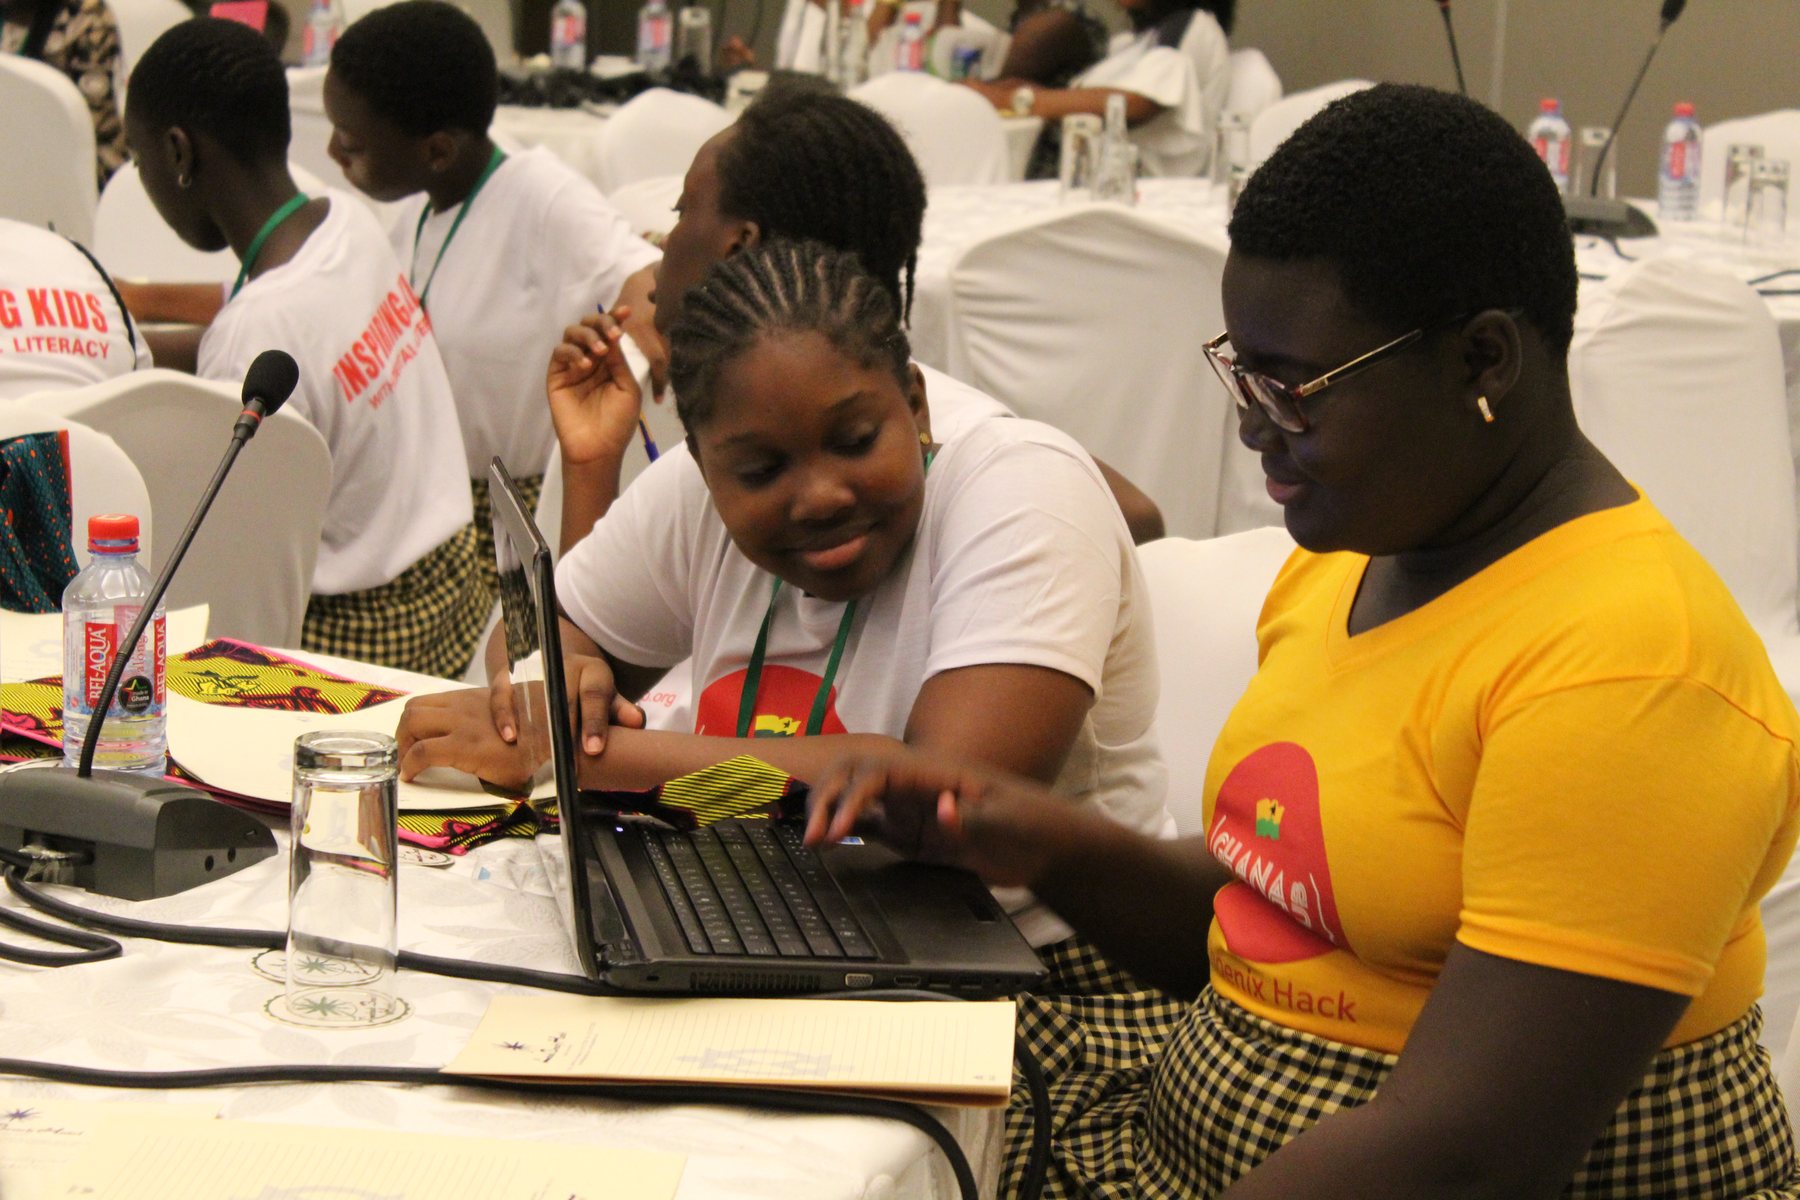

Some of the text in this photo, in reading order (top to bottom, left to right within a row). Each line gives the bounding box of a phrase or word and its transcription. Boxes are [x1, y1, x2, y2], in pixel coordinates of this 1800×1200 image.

[26, 288, 108, 334] KIDS
[13, 336, 109, 360] LITERACY
[1273, 977, 1357, 1023] Hack
